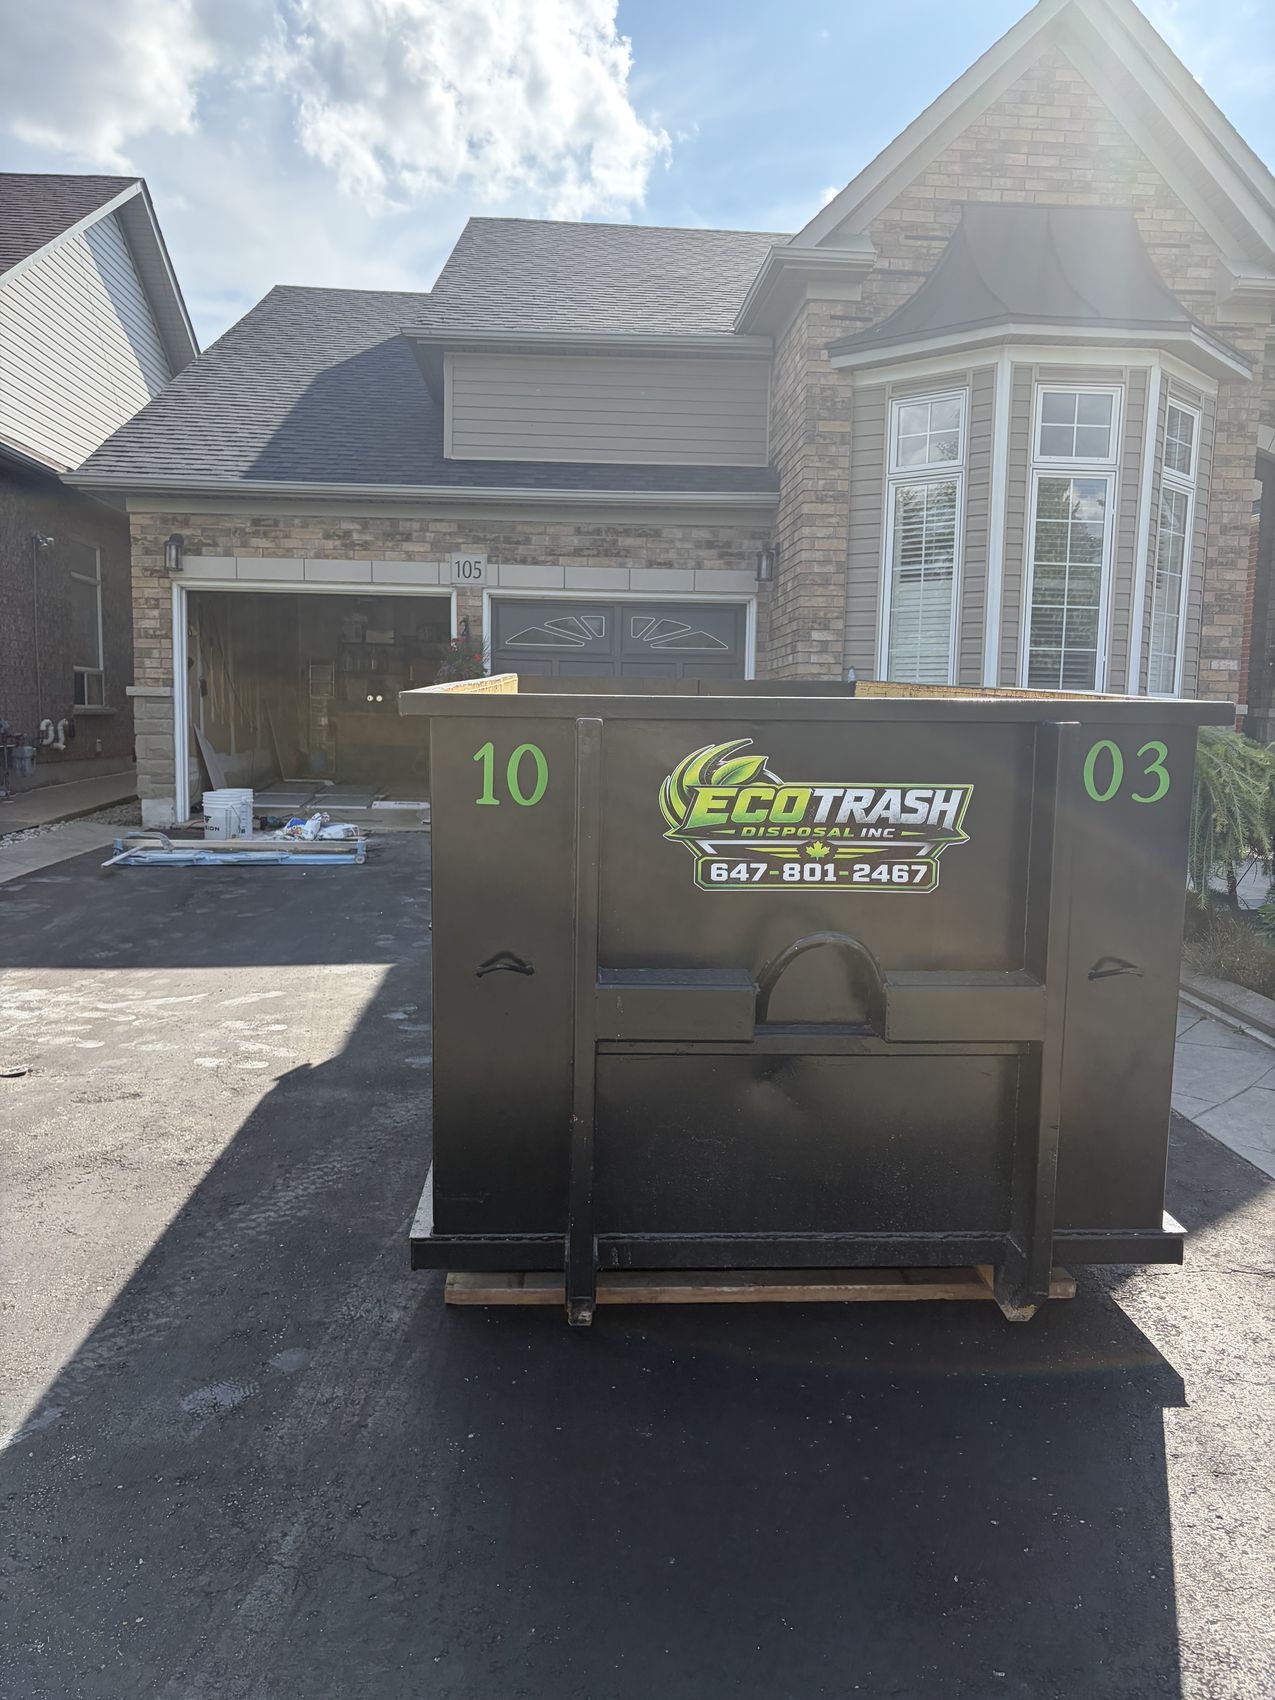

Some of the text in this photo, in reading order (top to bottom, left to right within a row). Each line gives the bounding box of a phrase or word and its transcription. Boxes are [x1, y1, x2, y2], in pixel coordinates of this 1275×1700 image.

[454, 560, 482, 579] 105
[473, 742, 549, 806] 10
[1083, 739, 1170, 803] 03
[684, 786, 964, 831] ECOTRASH
[740, 826, 896, 838] DISPOSAL INC
[709, 862, 928, 884] 647-801-2467
